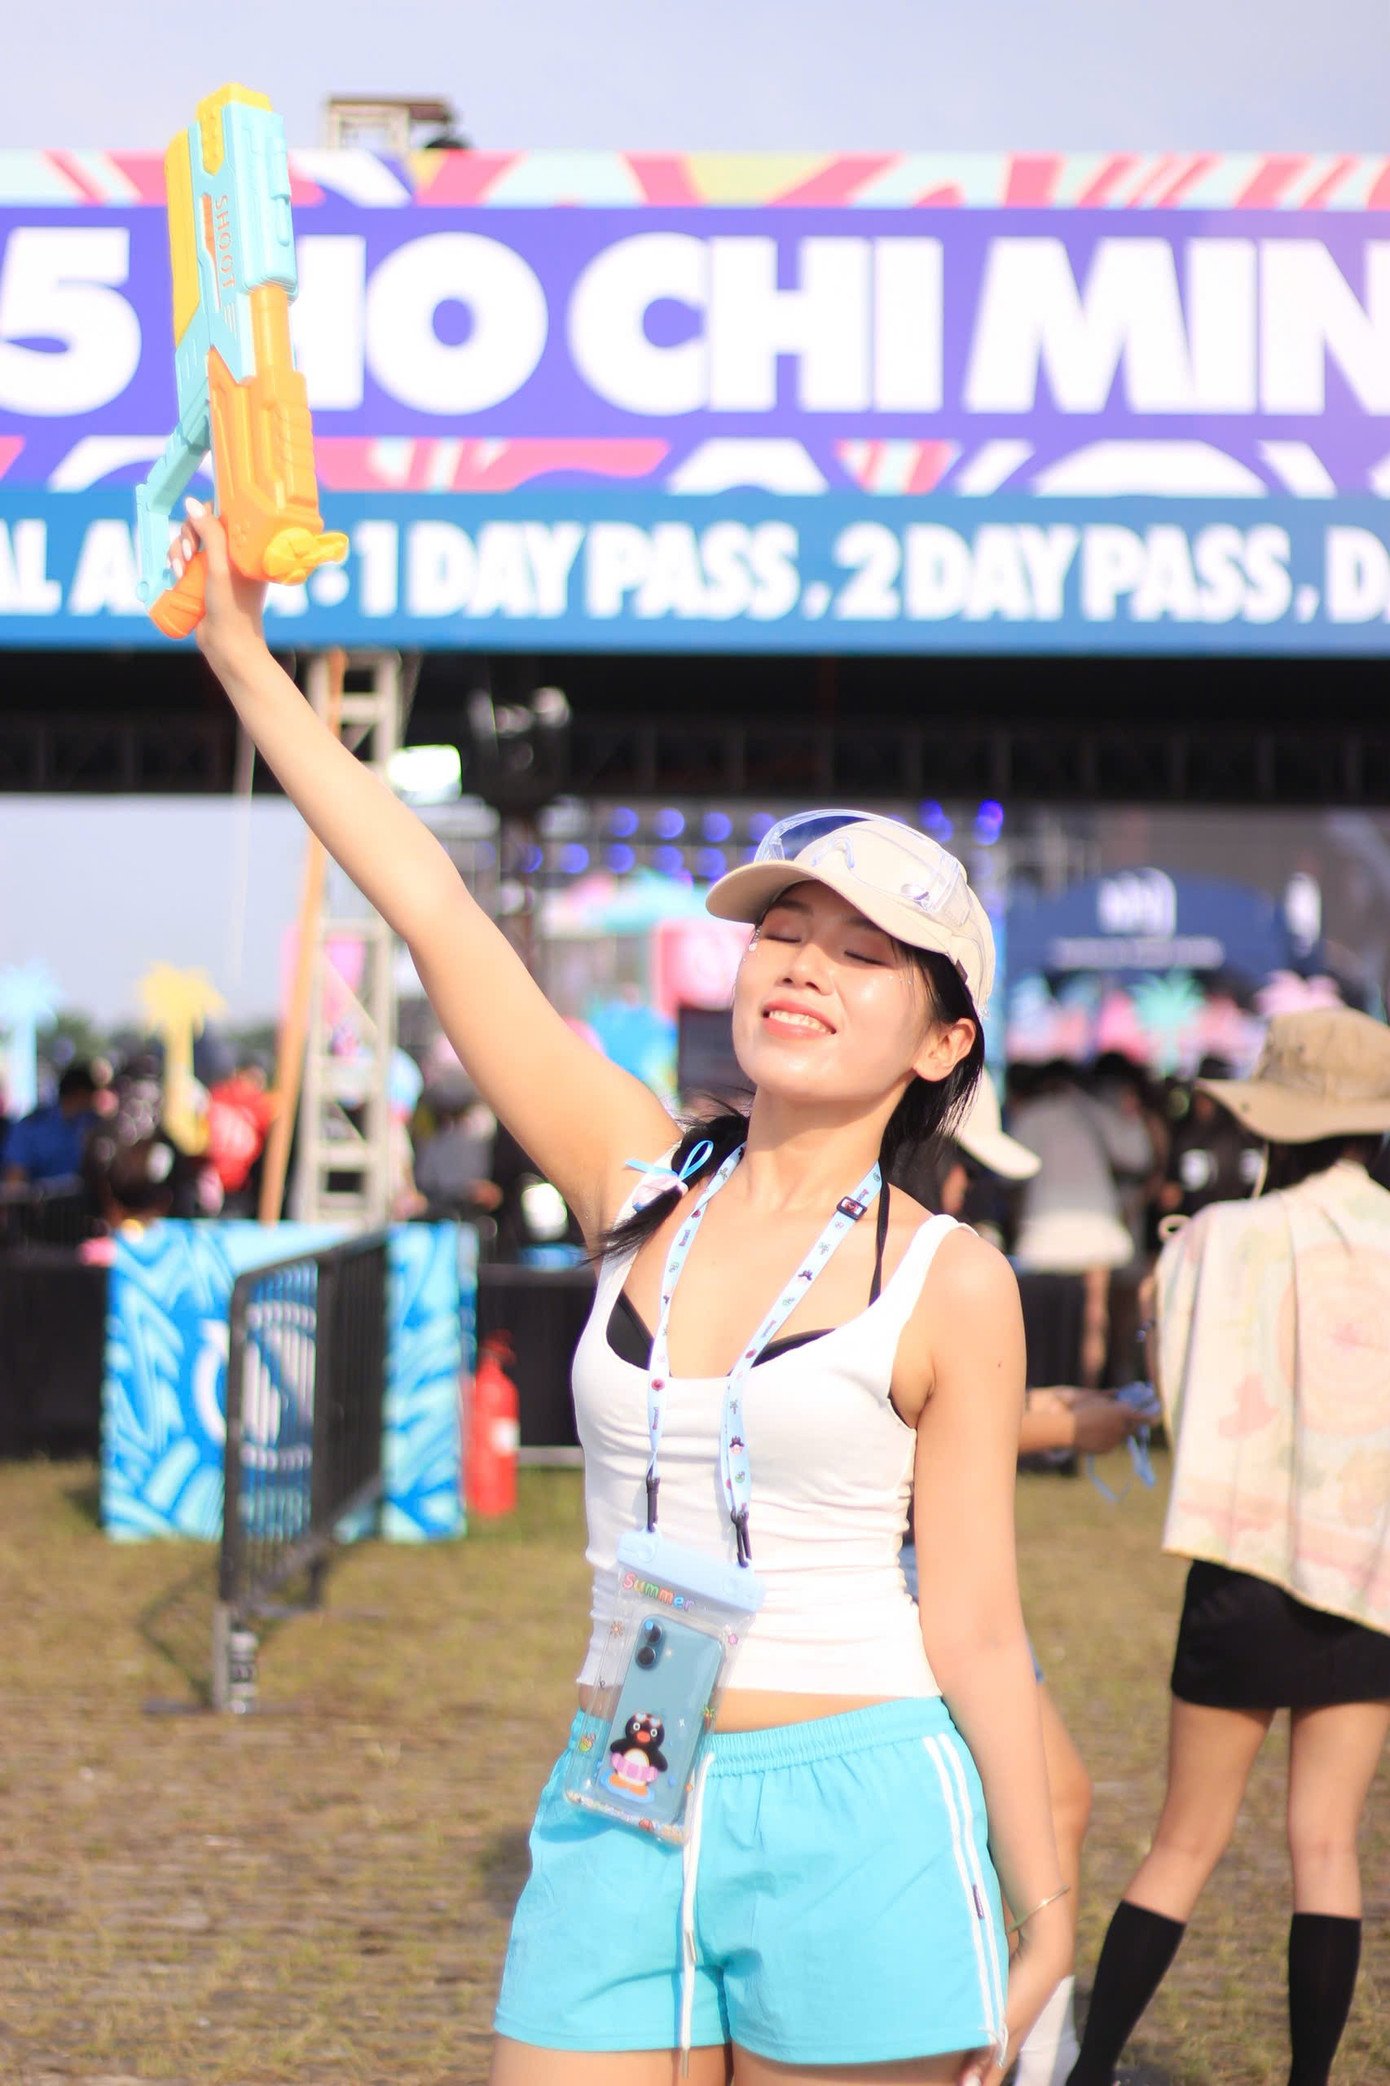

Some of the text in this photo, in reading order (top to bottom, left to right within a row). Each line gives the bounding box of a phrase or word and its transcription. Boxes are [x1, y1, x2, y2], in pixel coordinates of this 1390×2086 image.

[215, 194, 236, 288] SHOOT
[566, 231, 944, 415] CHI
[0, 517, 62, 616] L
[405, 519, 586, 619] DAY
[832, 520, 901, 621] 2
[903, 522, 1080, 622] DAY
[1324, 524, 1390, 625] D
[622, 1571, 695, 1612] Summer
